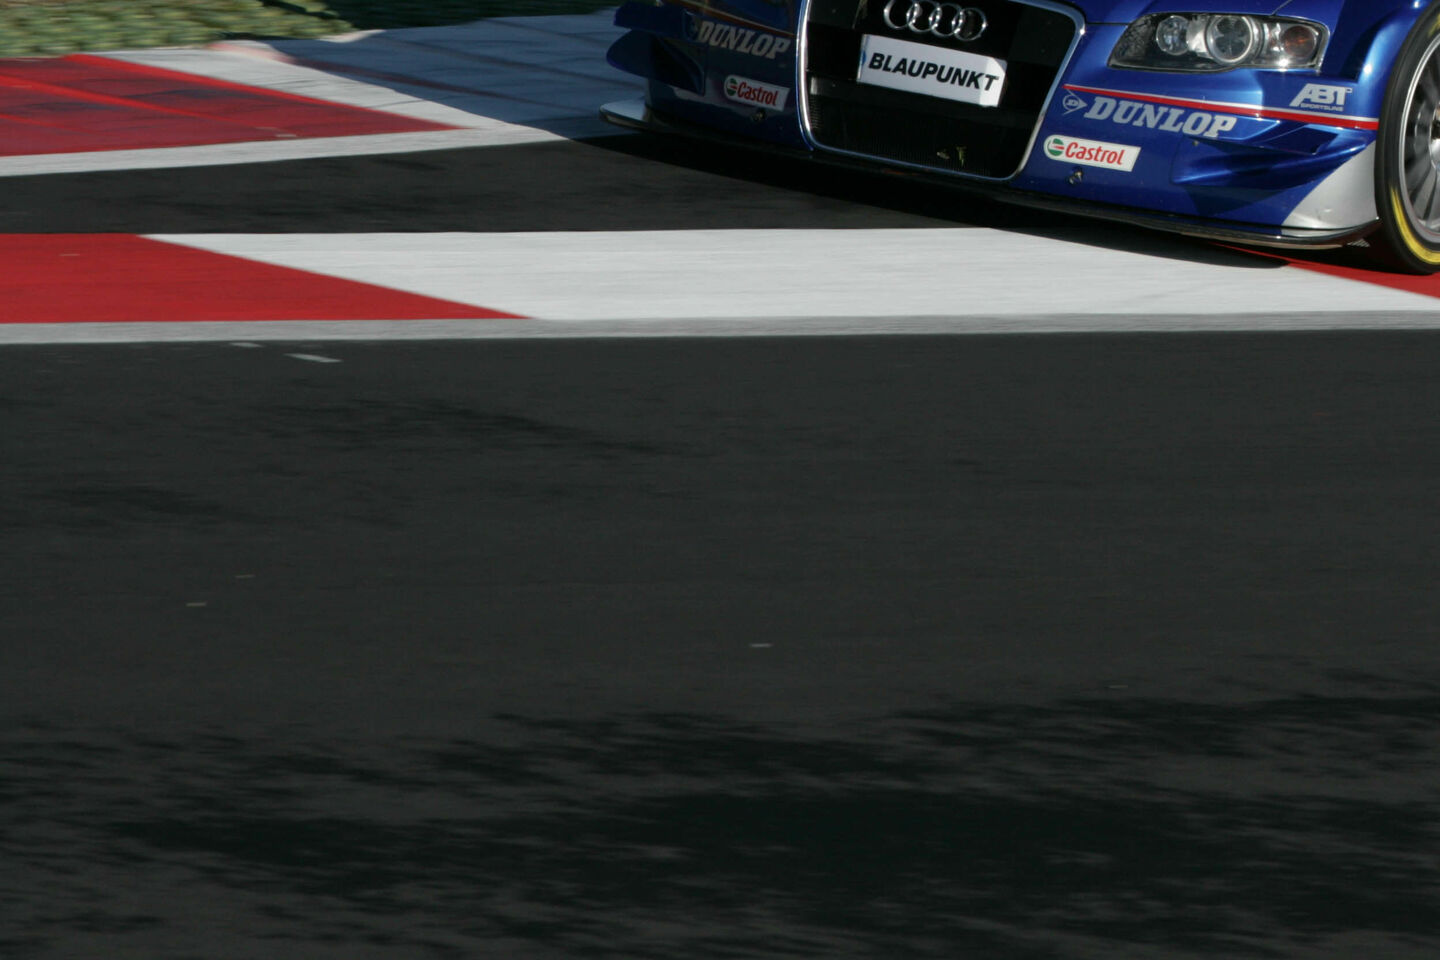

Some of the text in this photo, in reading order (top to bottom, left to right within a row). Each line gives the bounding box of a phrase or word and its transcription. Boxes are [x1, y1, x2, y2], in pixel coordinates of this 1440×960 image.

[696, 21, 791, 60] DUNLOP
[868, 52, 999, 91] BLAUPUNKT
[737, 81, 779, 106] Castrol
[1289, 83, 1346, 107] ABT
[1083, 96, 1238, 138] DUNLOP
[1065, 141, 1126, 166] Castrol
